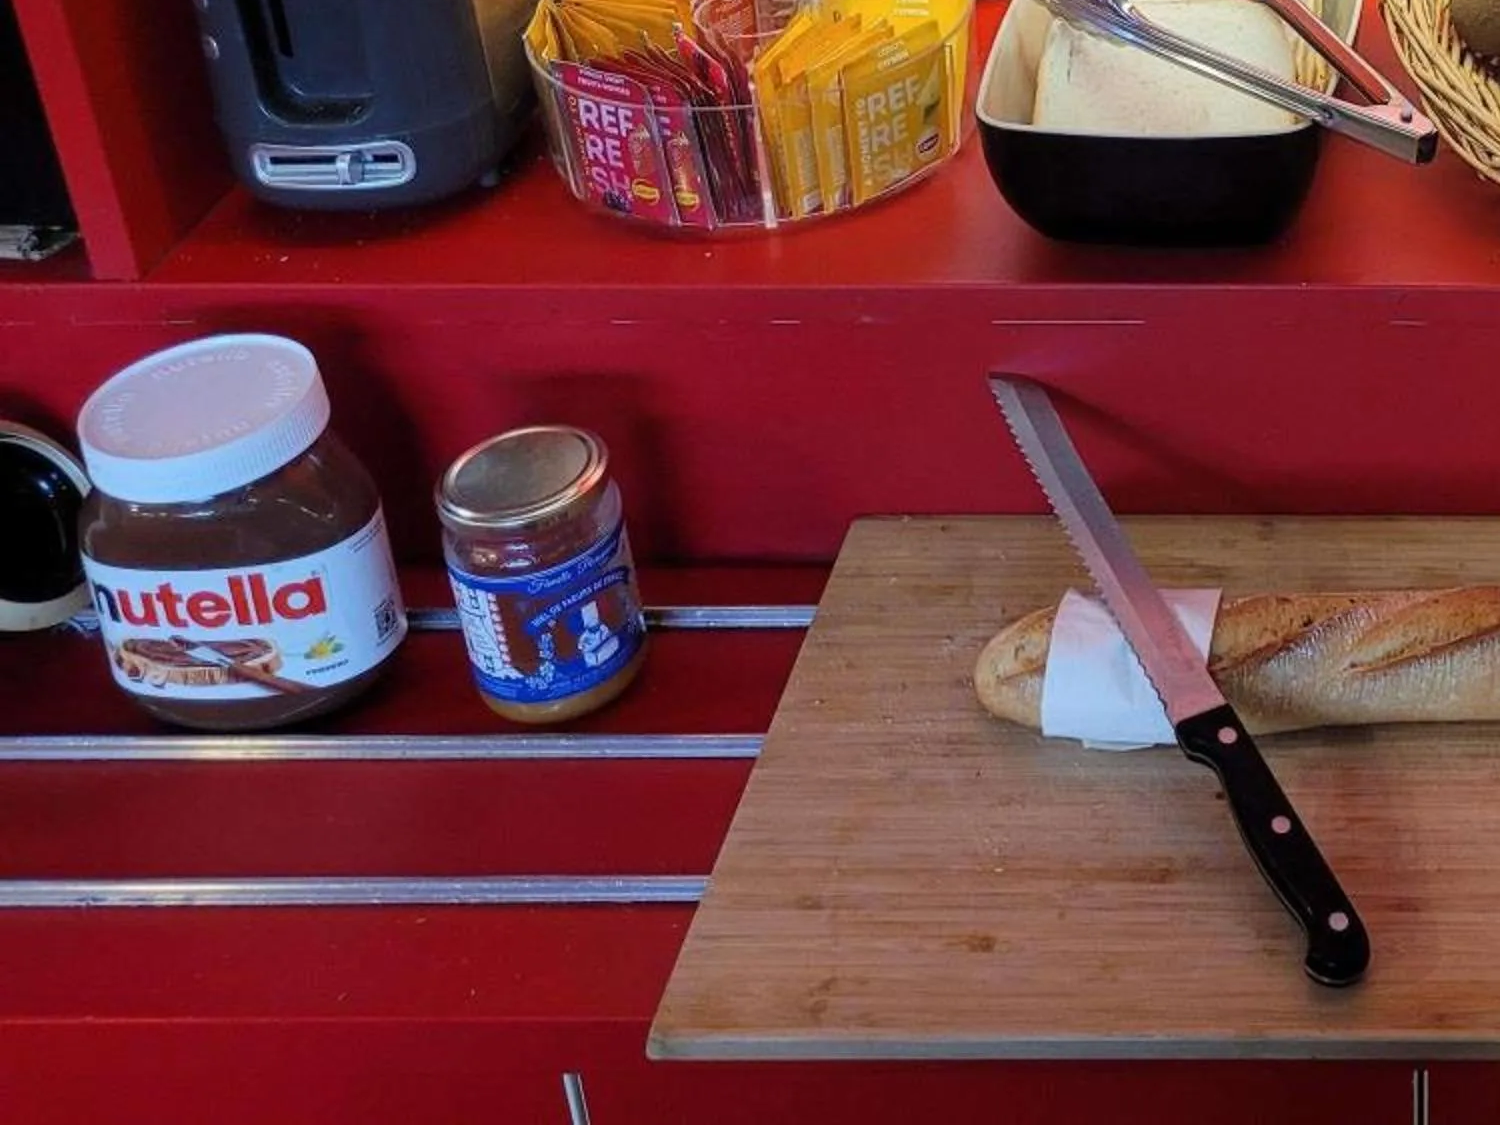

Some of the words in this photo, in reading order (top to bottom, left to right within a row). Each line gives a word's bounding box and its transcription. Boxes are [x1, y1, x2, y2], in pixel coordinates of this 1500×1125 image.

[578, 98, 633, 137] REF
[586, 134, 625, 169] RE
[92, 572, 328, 629] nutella
